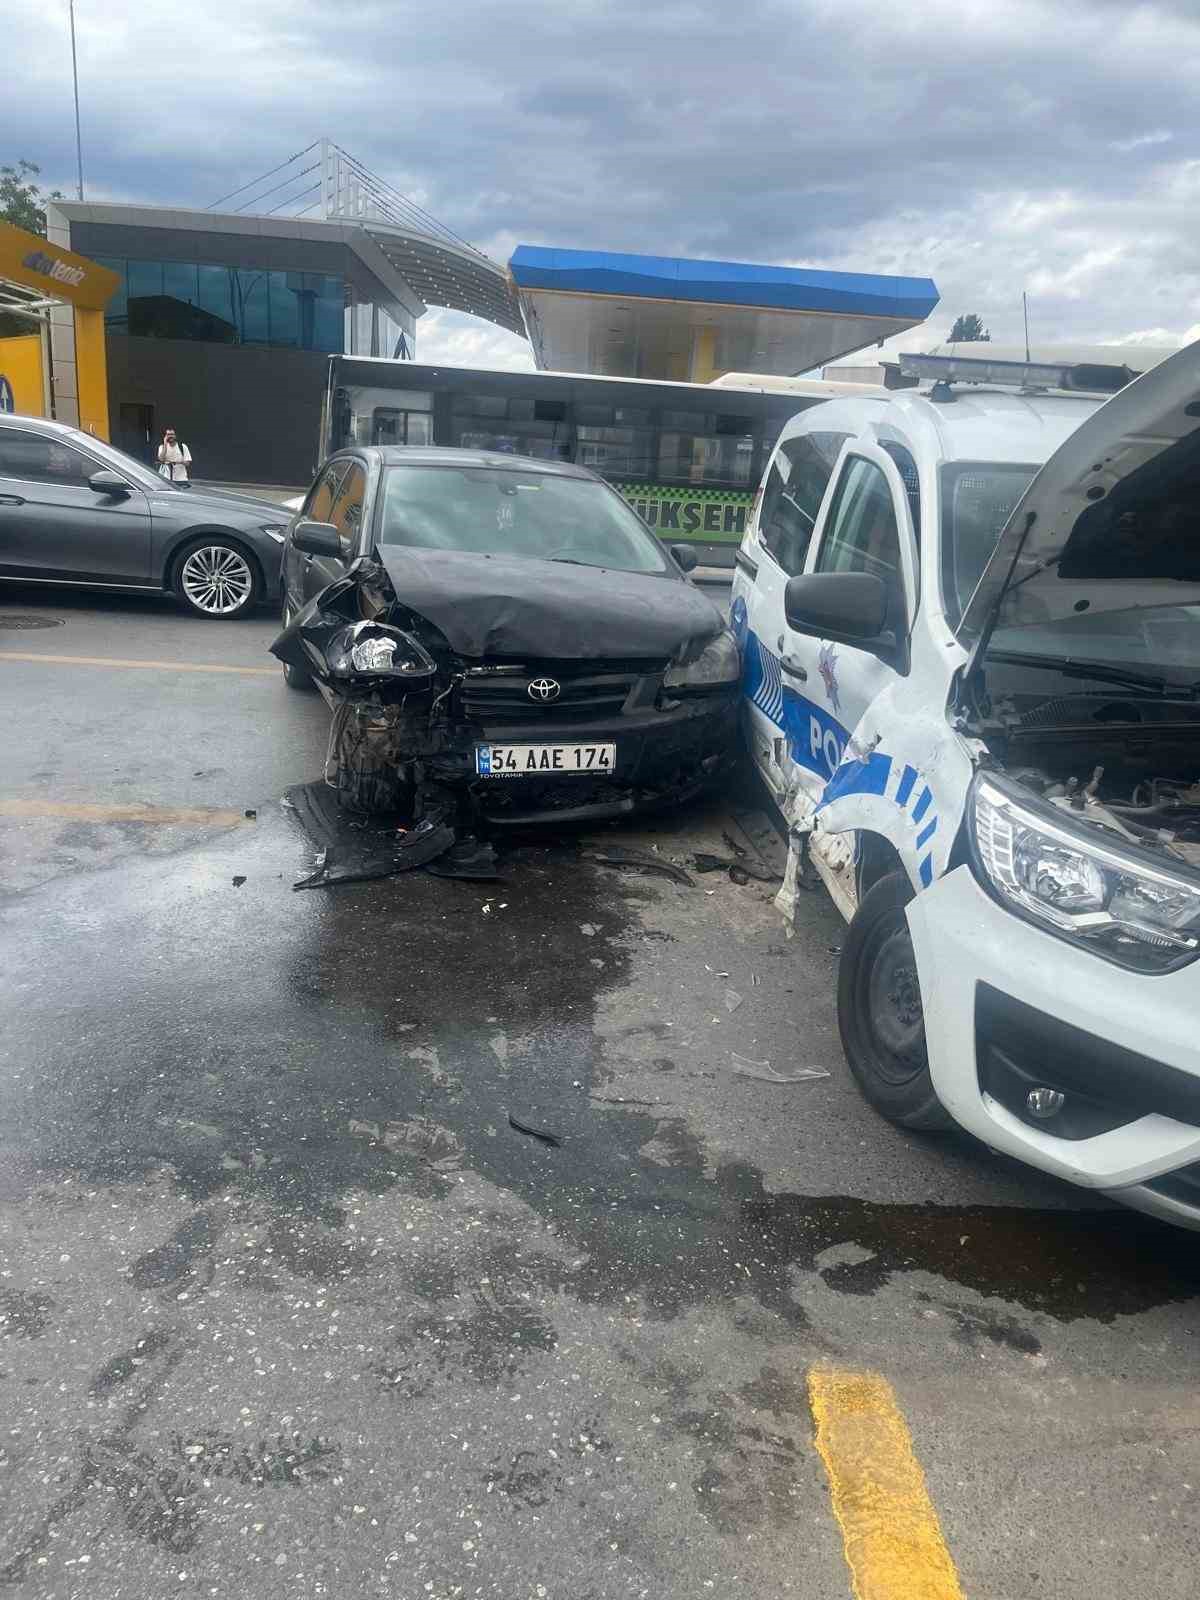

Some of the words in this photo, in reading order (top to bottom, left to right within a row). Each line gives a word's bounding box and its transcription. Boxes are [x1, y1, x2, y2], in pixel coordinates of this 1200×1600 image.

[492, 749, 517, 770] 54
[526, 749, 563, 769] AAE
[574, 748, 609, 768] 174
[809, 714, 847, 775] PO
